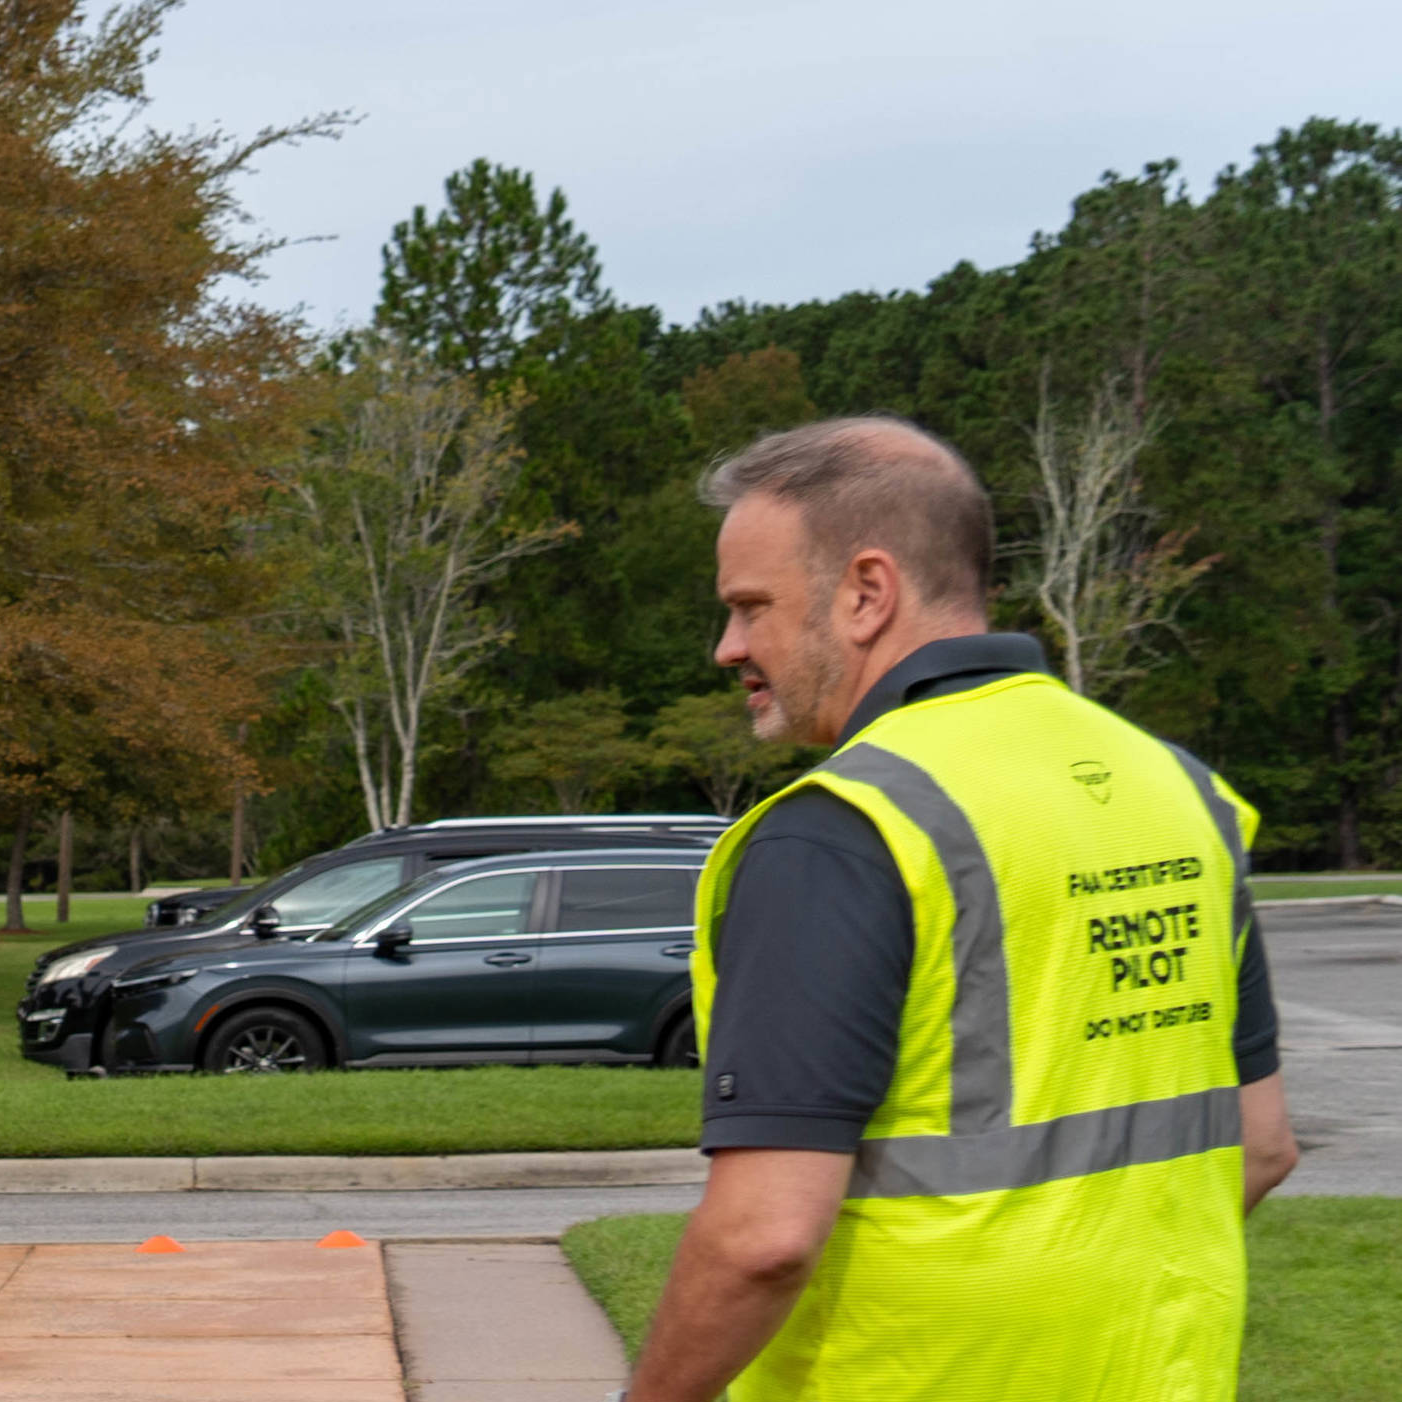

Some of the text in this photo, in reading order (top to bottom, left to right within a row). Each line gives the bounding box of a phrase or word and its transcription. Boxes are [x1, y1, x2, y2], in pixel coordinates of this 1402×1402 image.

[1068, 856, 1203, 898] FAA CERTIFIED
[1088, 902, 1199, 955] REMOTE
[1110, 947, 1188, 992] PILOT
[1085, 1018, 1111, 1041] DO
[1117, 1011, 1147, 1036] NOT
